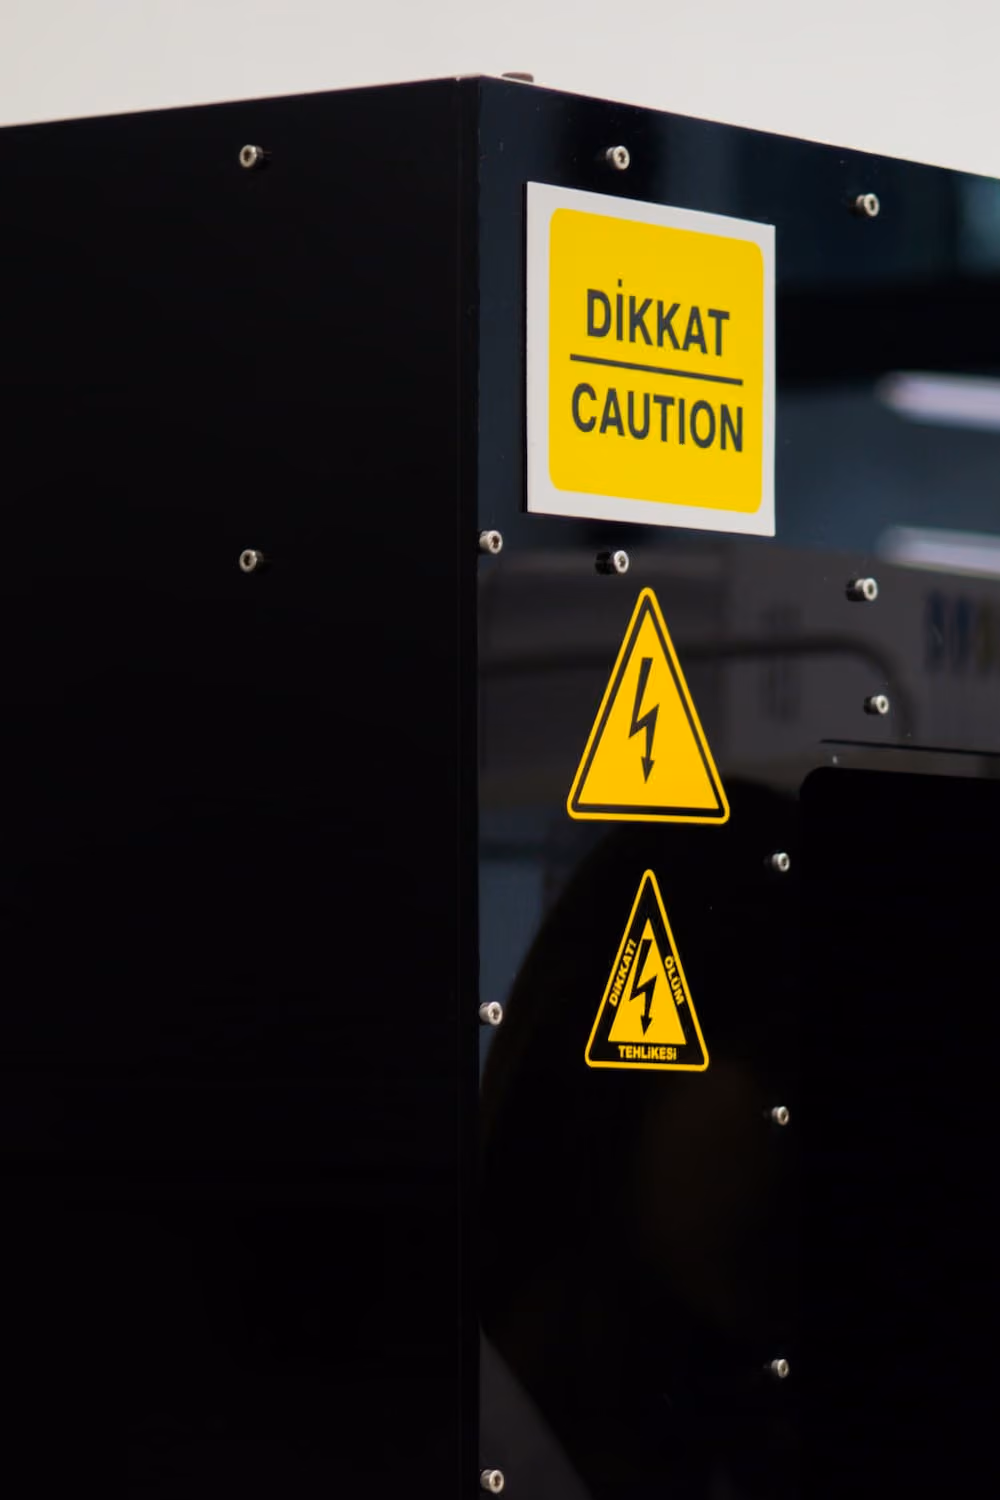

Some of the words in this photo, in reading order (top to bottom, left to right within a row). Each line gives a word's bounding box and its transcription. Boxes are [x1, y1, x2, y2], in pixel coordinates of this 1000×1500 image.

[586, 278, 730, 357] DİKKAT
[571, 382, 743, 453] CAUTION
[664, 955, 685, 1005] ÖLÜM
